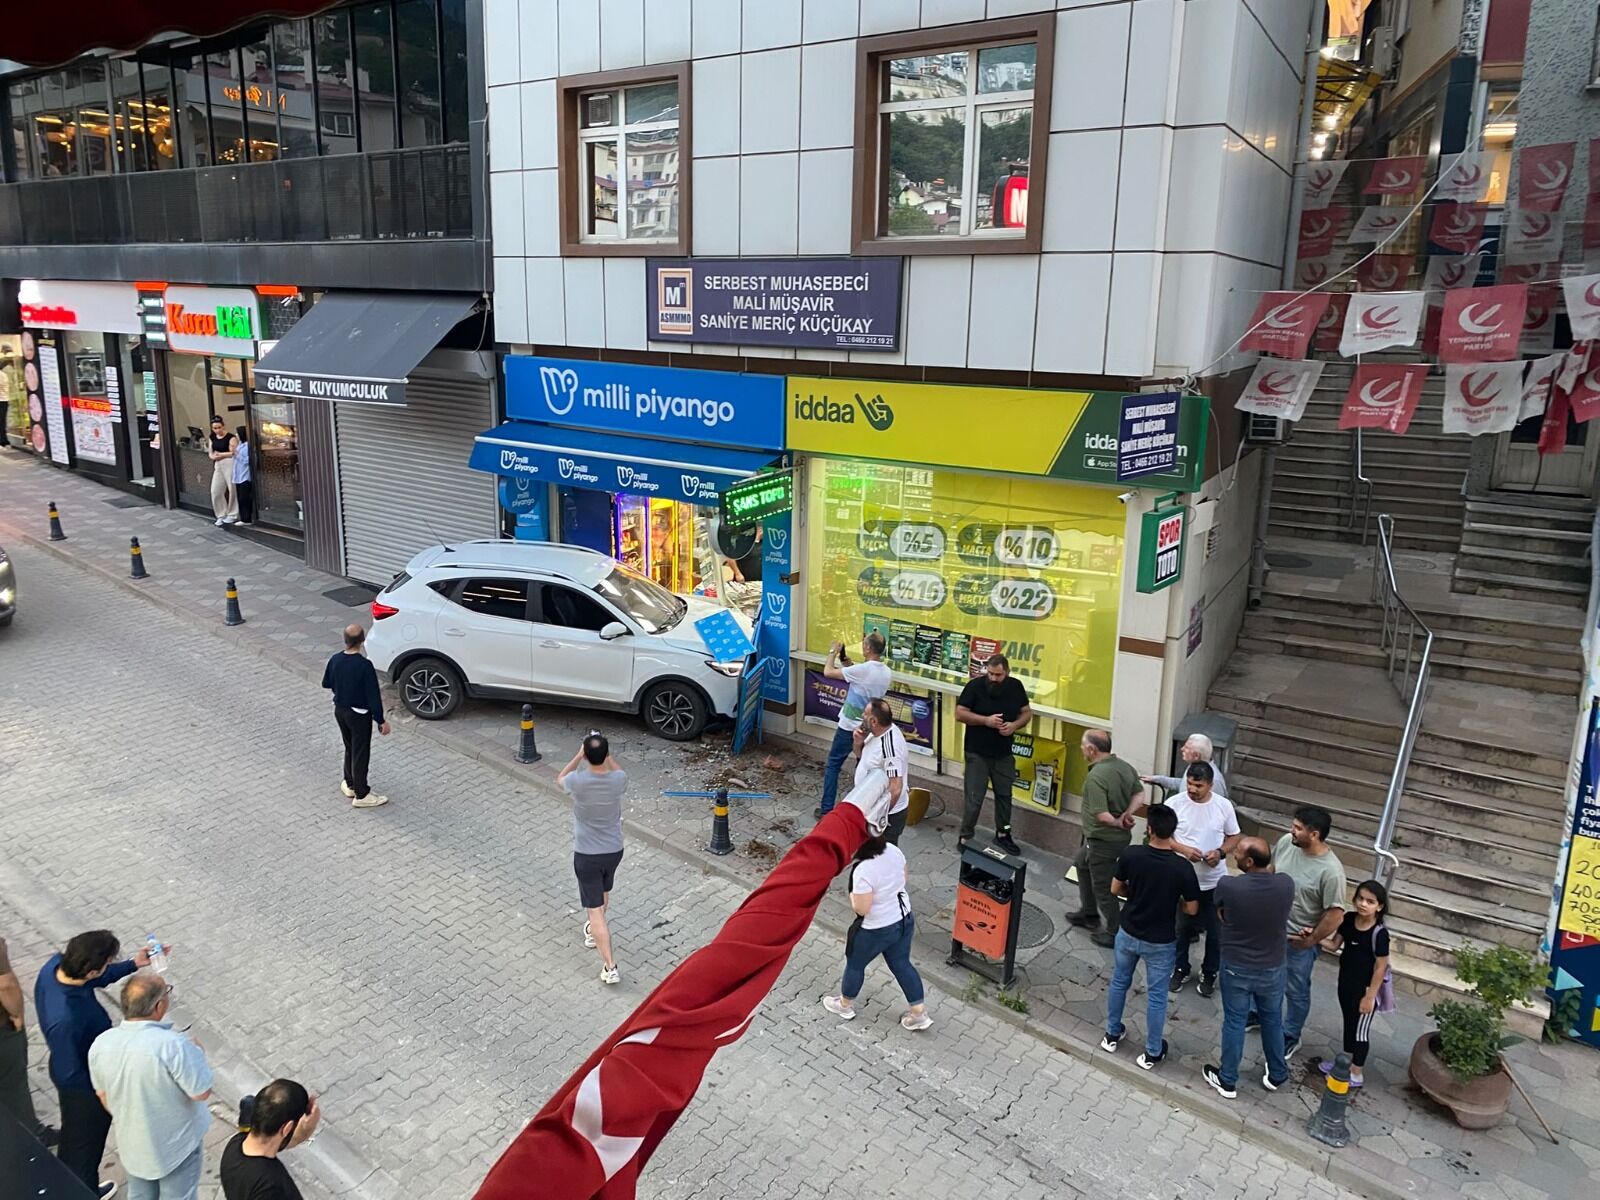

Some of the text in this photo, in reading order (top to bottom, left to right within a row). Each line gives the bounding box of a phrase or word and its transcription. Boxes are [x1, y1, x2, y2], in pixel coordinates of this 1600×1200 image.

[704, 272, 869, 291] SERBEST MUHASEBECİ
[733, 293, 834, 314] MALİ MÜŞAVİR
[167, 304, 218, 336] Kuru
[700, 312, 873, 335] SANİYE MERİÇ KÜÇÜKAY
[267, 374, 389, 400] GÖZDE KUYUMCULUK
[583, 383, 734, 427] milli piyango
[795, 393, 855, 424] iddaa
[514, 463, 539, 474] piyango
[573, 472, 598, 483] piyango
[633, 472, 648, 481] milli
[633, 480, 659, 491] piyango
[699, 481, 715, 491] milli
[903, 531, 934, 554] %5
[1158, 517, 1181, 549] SPOR
[1005, 535, 1052, 559] %10
[1157, 548, 1178, 580] TOTO
[1000, 586, 1048, 611] %22
